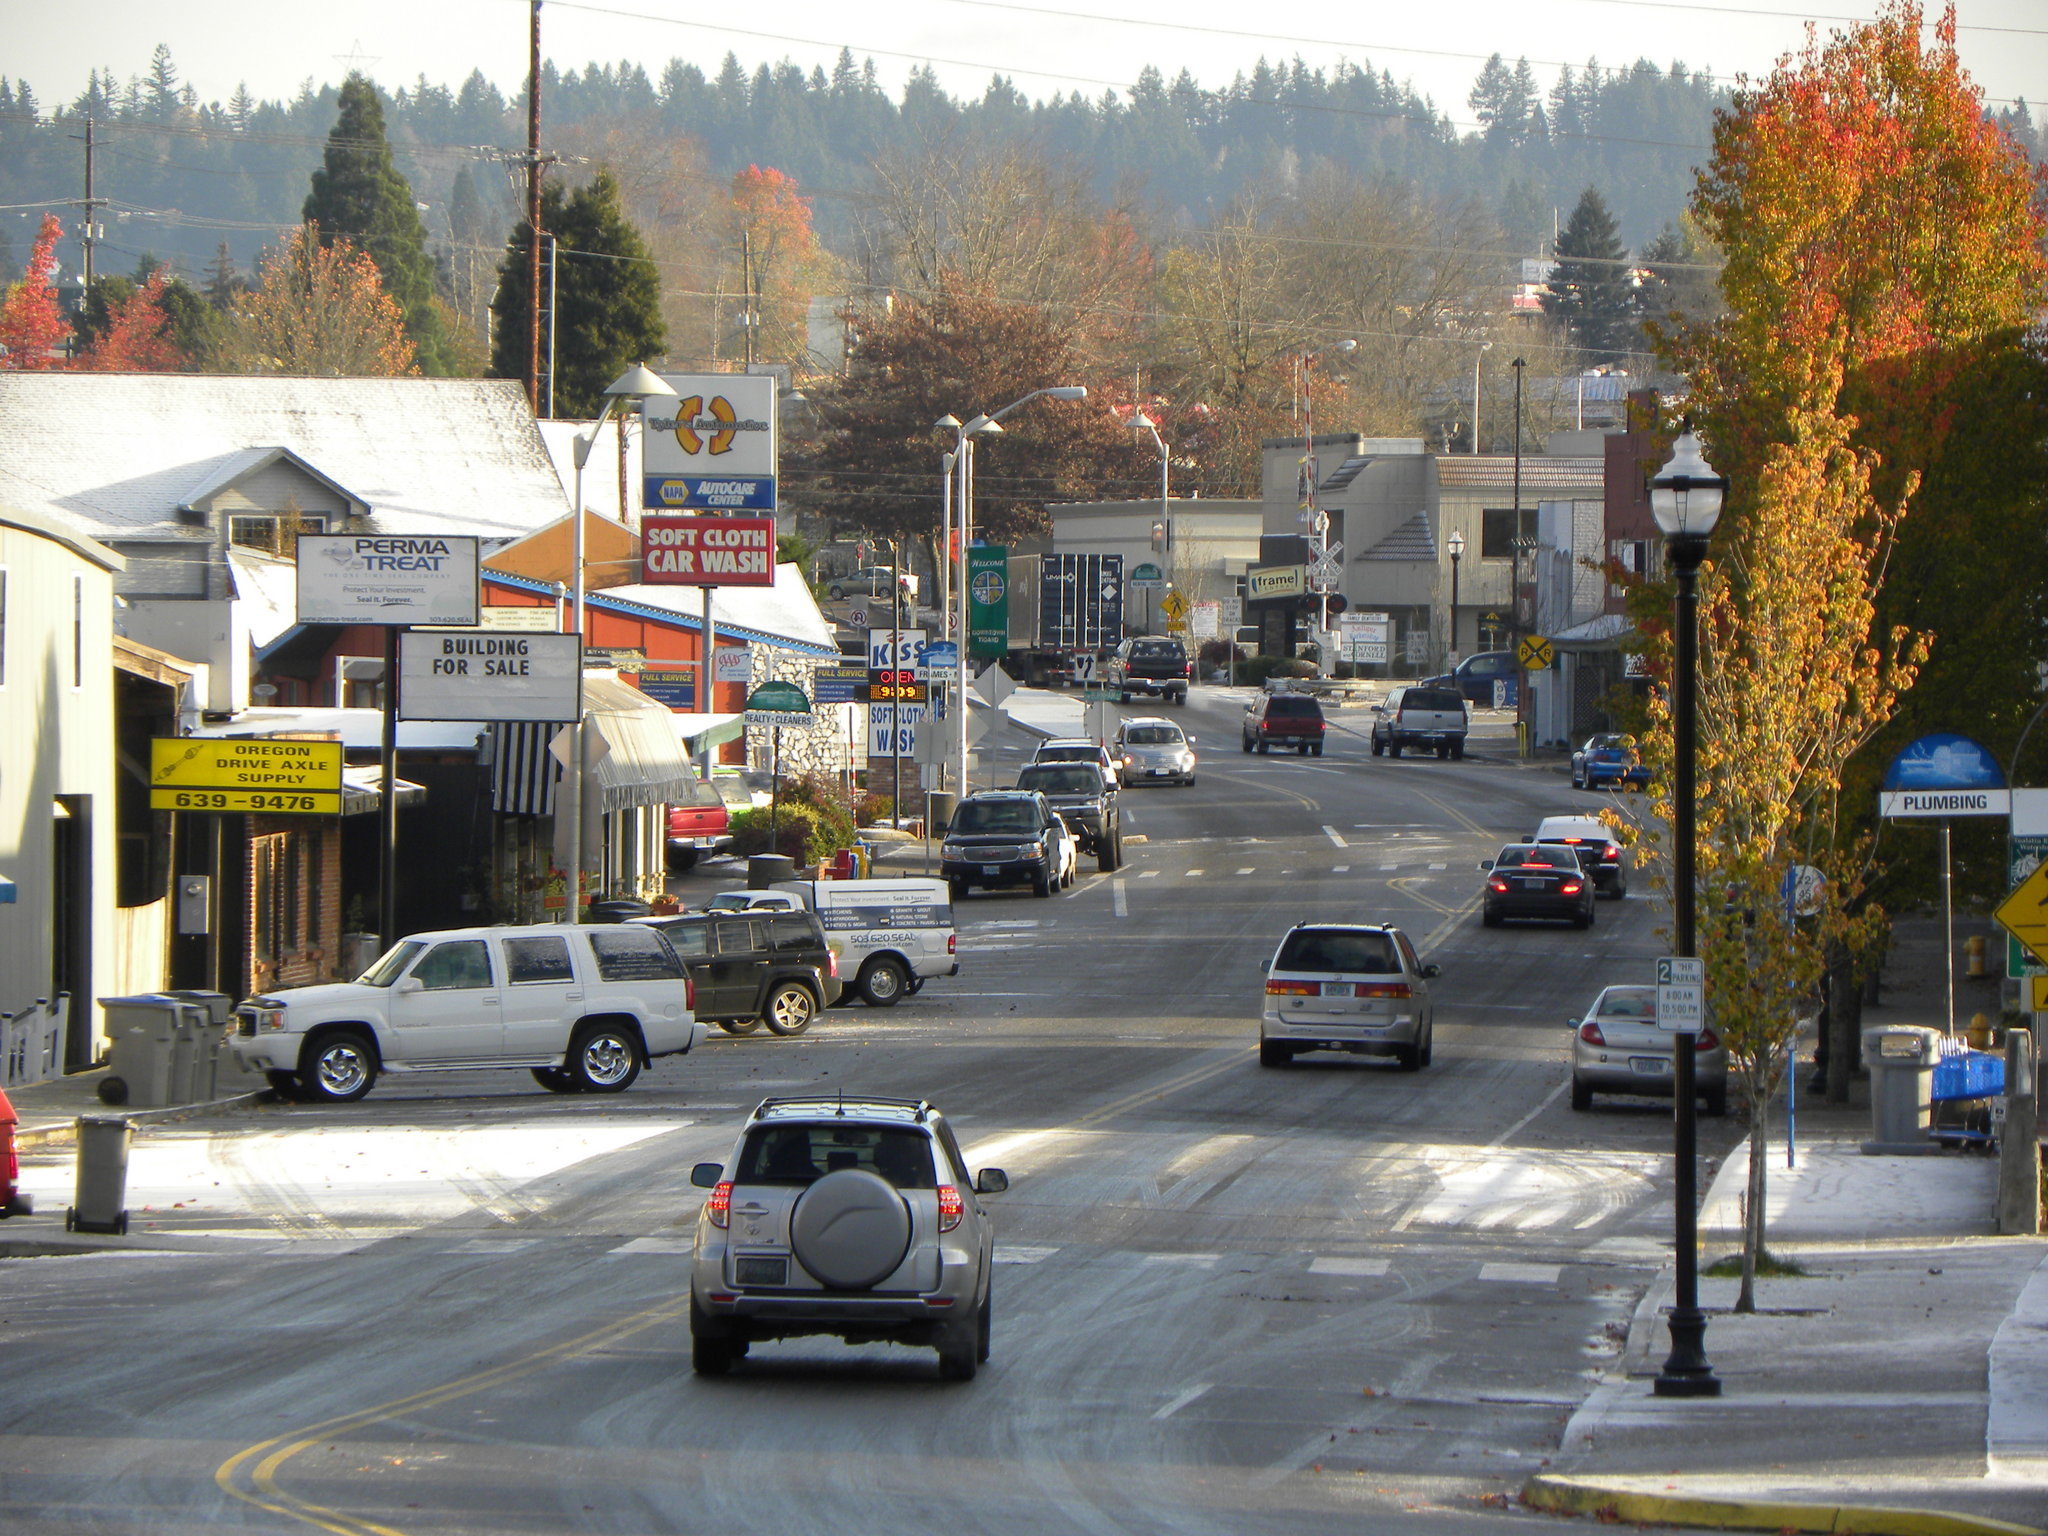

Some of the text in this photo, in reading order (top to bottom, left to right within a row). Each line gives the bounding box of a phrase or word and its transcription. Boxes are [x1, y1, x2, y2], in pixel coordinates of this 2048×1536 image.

[693, 417, 769, 432] Automotive
[663, 486, 683, 498] NAPA
[707, 495, 744, 505] CENTER
[648, 528, 766, 547] SOFT CLOTH
[355, 539, 449, 554] PERMA
[361, 555, 444, 571] TREAT
[647, 550, 767, 574] CAR WASH
[971, 559, 1005, 568] WELCOME
[1257, 576, 1295, 587] frame
[343, 586, 368, 594] Protect
[443, 639, 529, 655] BUILDING
[1521, 648, 1528, 656] R
[1544, 648, 1551, 657] R
[872, 640, 925, 667] KSS
[433, 659, 530, 676] FOR SALE
[661, 674, 691, 682] SERVICE
[776, 716, 812, 725] CLEANERS
[871, 707, 893, 724] SOFT
[235, 746, 310, 756] OREGON
[216, 759, 328, 771] DRIVE AXLE
[237, 773, 306, 784] SUPPLY
[1904, 795, 1988, 811] PLUMBING
[850, 933, 916, 944] 503.620.SEAL
[1659, 963, 1693, 982] 2 HR
[1672, 973, 1701, 982] PARKING
[1683, 991, 1694, 1000] AM
[1663, 1004, 1671, 1013] TO
[1688, 1004, 1698, 1013] PM
